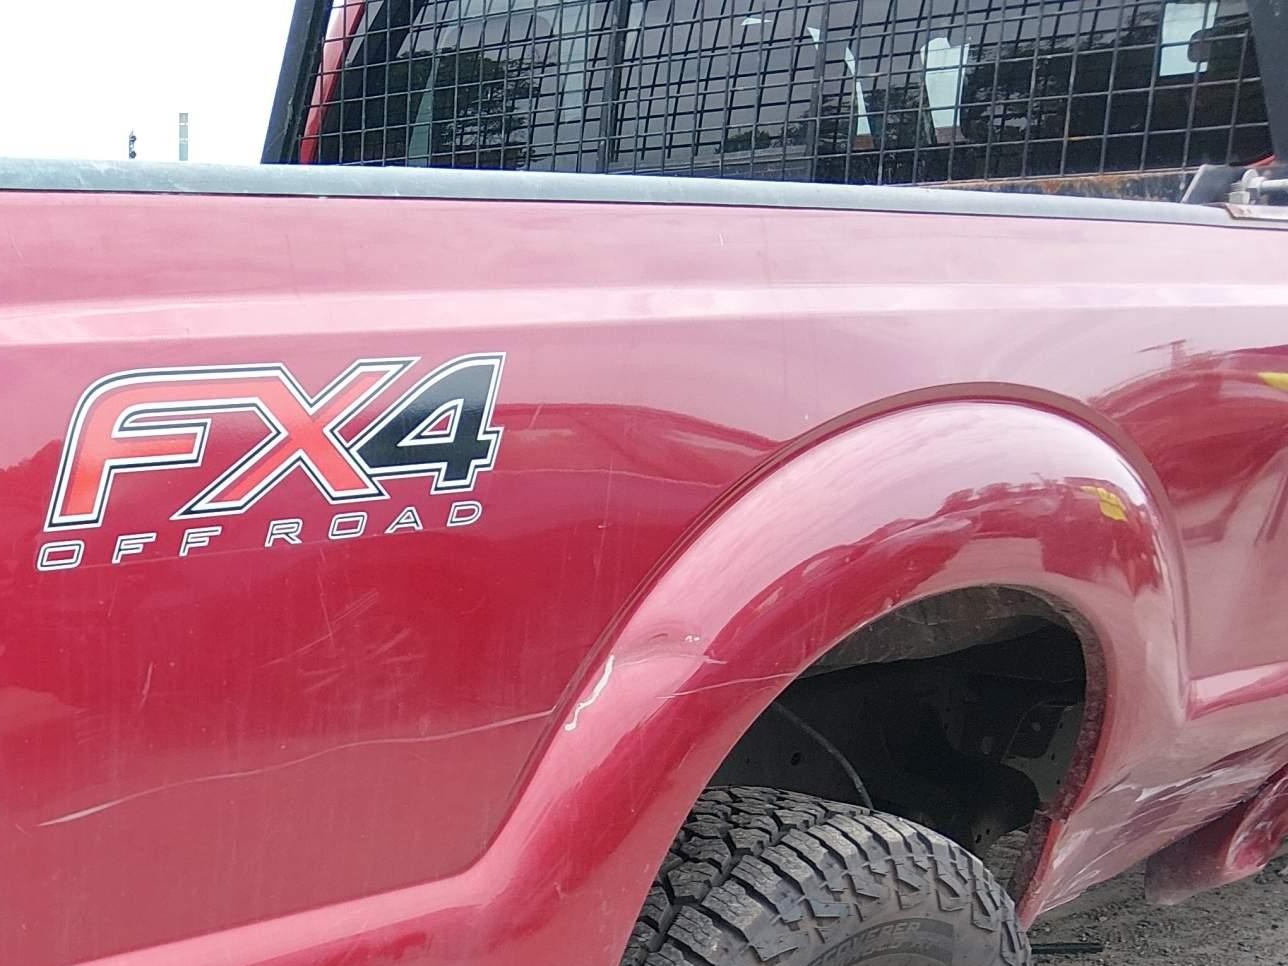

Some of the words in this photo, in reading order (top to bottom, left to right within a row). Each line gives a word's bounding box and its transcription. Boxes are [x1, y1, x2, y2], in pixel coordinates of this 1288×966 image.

[43, 351, 507, 532] FX4
[36, 526, 223, 572] OFF
[264, 501, 483, 547] ROAD
